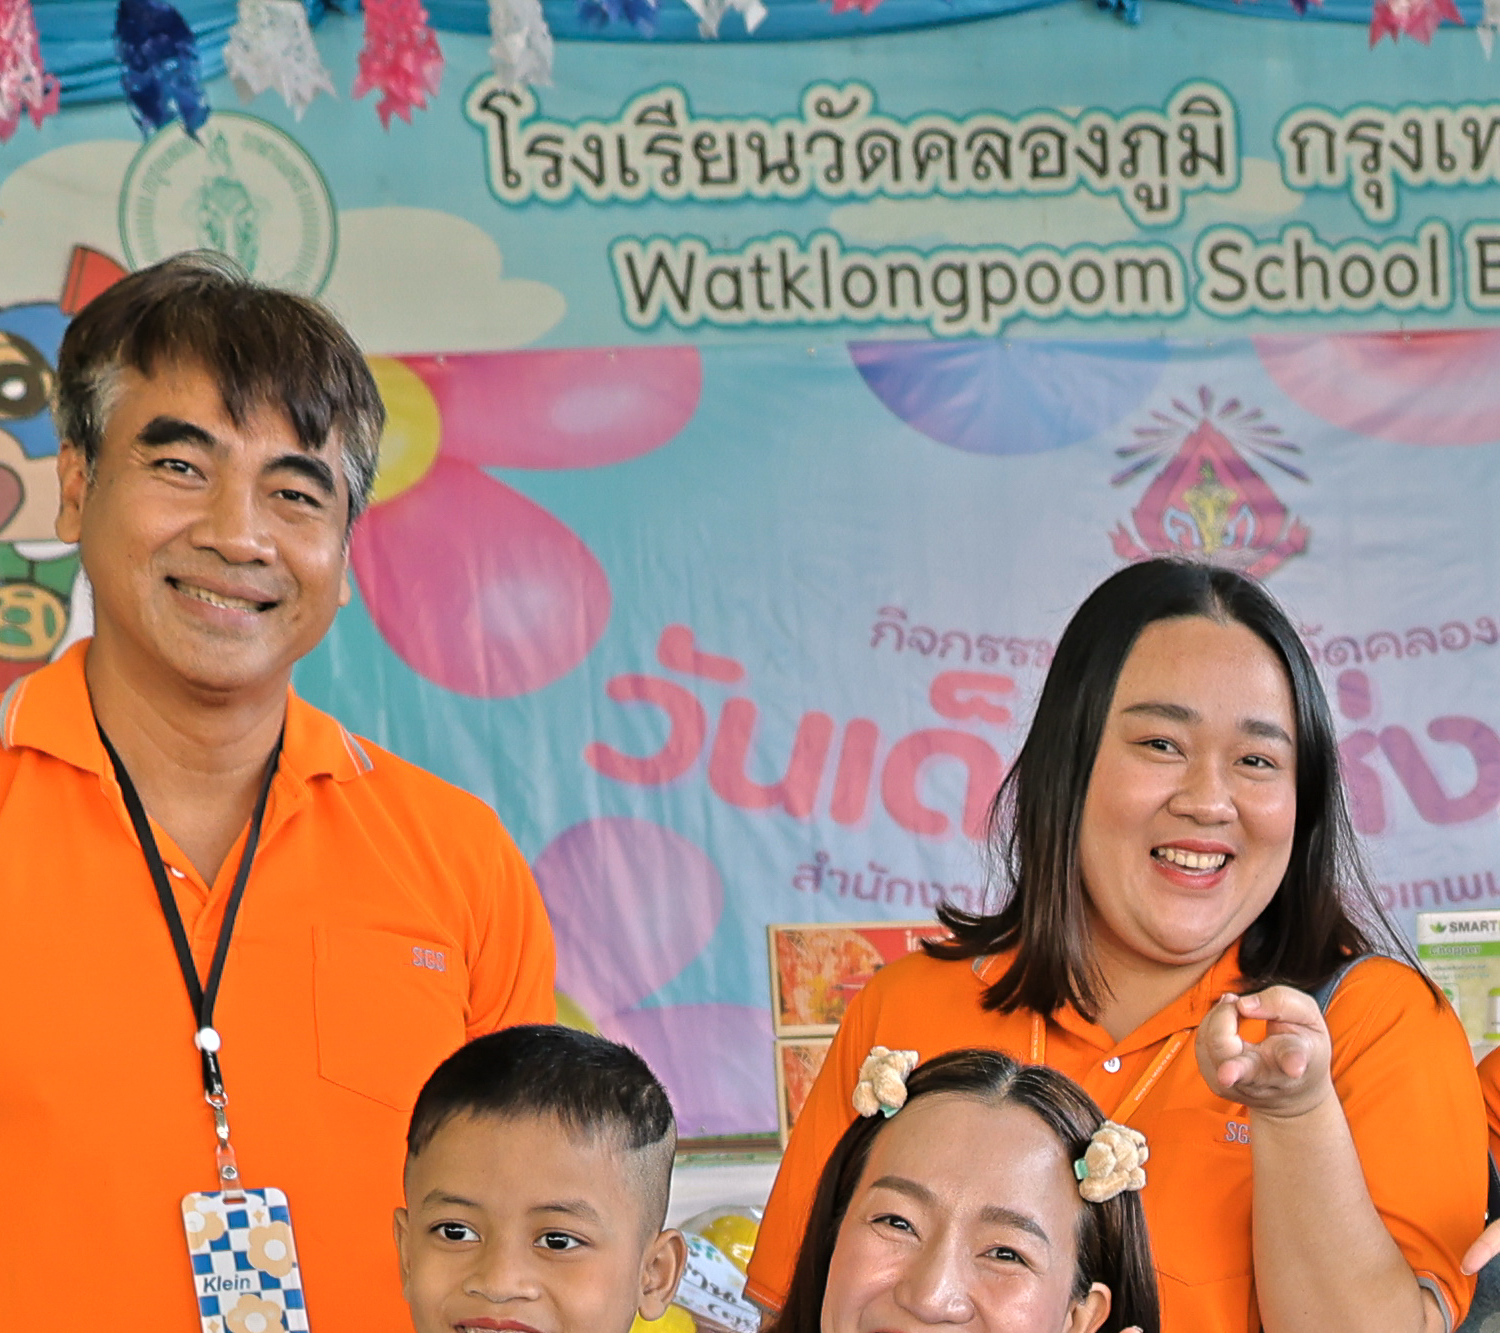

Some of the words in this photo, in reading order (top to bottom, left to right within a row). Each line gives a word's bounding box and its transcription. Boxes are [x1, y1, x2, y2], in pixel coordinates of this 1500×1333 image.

[478, 89, 1226, 213] โรงเรียนวัดคลองภูมิ
[626, 247, 1173, 323] Watklongpoom
[1208, 232, 1439, 302] School
[412, 946, 447, 972] SGS
[203, 1274, 251, 1293] Klein
